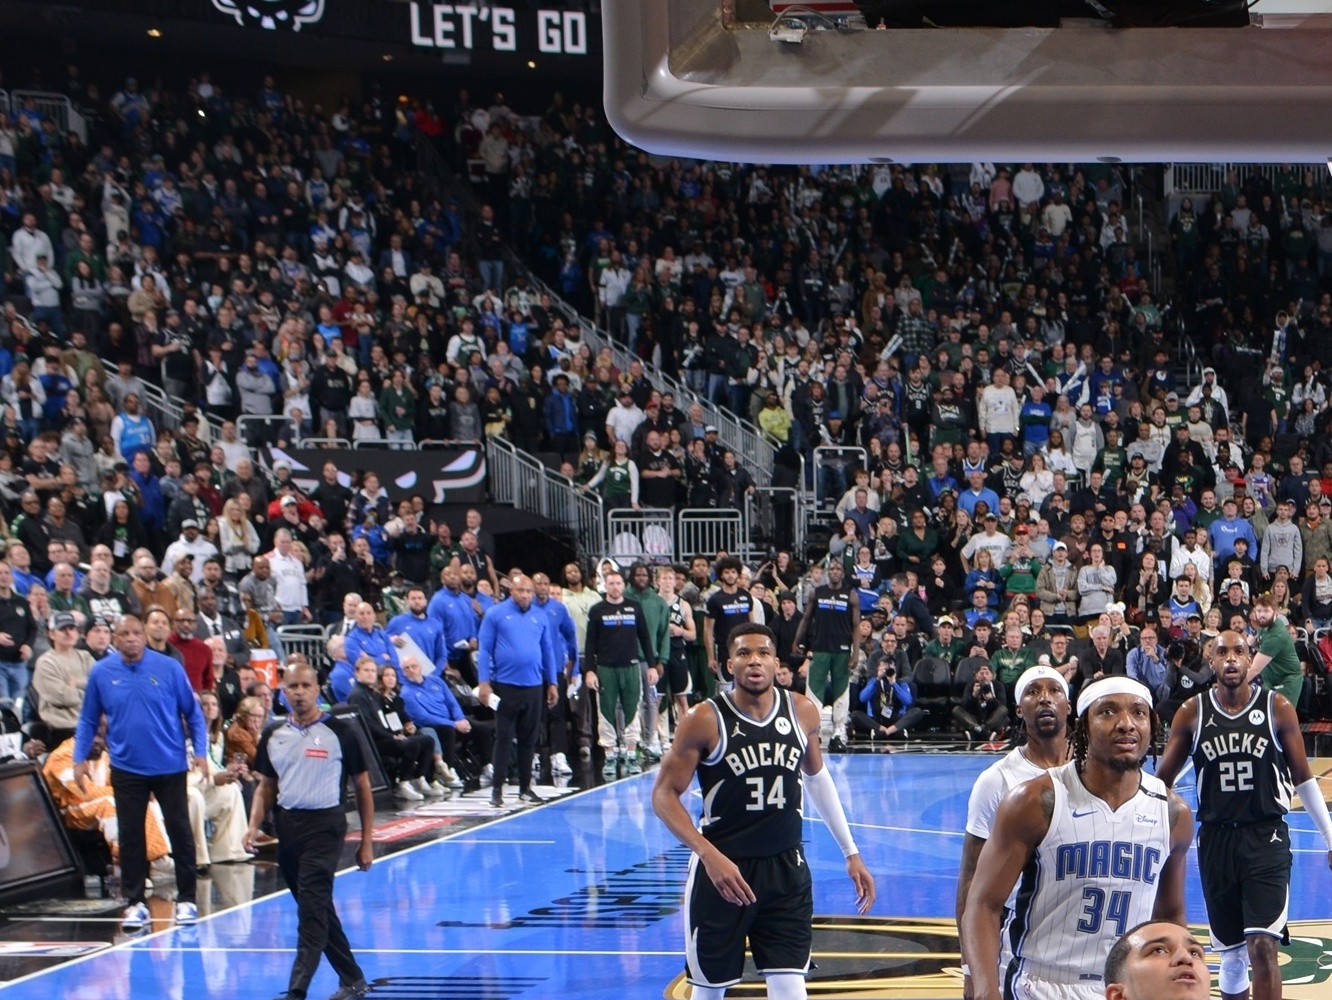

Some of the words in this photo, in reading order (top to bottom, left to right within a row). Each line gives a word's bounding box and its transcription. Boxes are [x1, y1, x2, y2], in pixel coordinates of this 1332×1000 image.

[410, 1, 516, 51] LET'S
[537, 9, 587, 54] GO
[725, 742, 801, 777] BUCKS
[1200, 732, 1269, 762] BUCKS
[745, 775, 787, 811] 34
[1219, 761, 1254, 792] 22
[1135, 813, 1158, 827] Disney
[1055, 840, 1162, 885] MAGIC
[1076, 887, 1132, 938] 34
